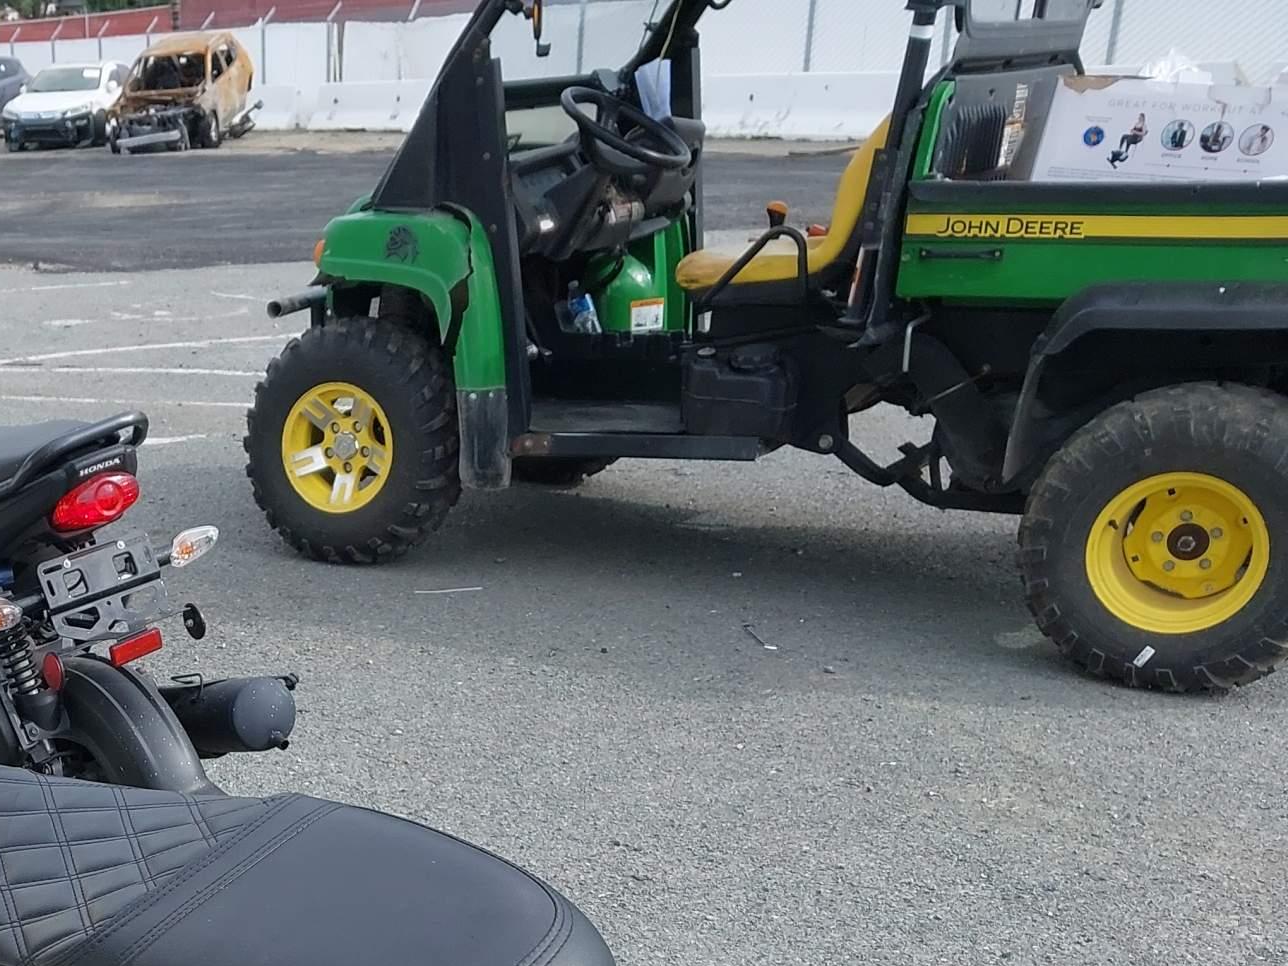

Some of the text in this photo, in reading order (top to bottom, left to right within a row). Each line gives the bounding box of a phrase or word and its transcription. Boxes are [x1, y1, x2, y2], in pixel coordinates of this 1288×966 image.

[1181, 103, 1243, 115] WORKUT
[936, 215, 1085, 237] JOHN DEERE
[79, 457, 121, 478] HONDA
